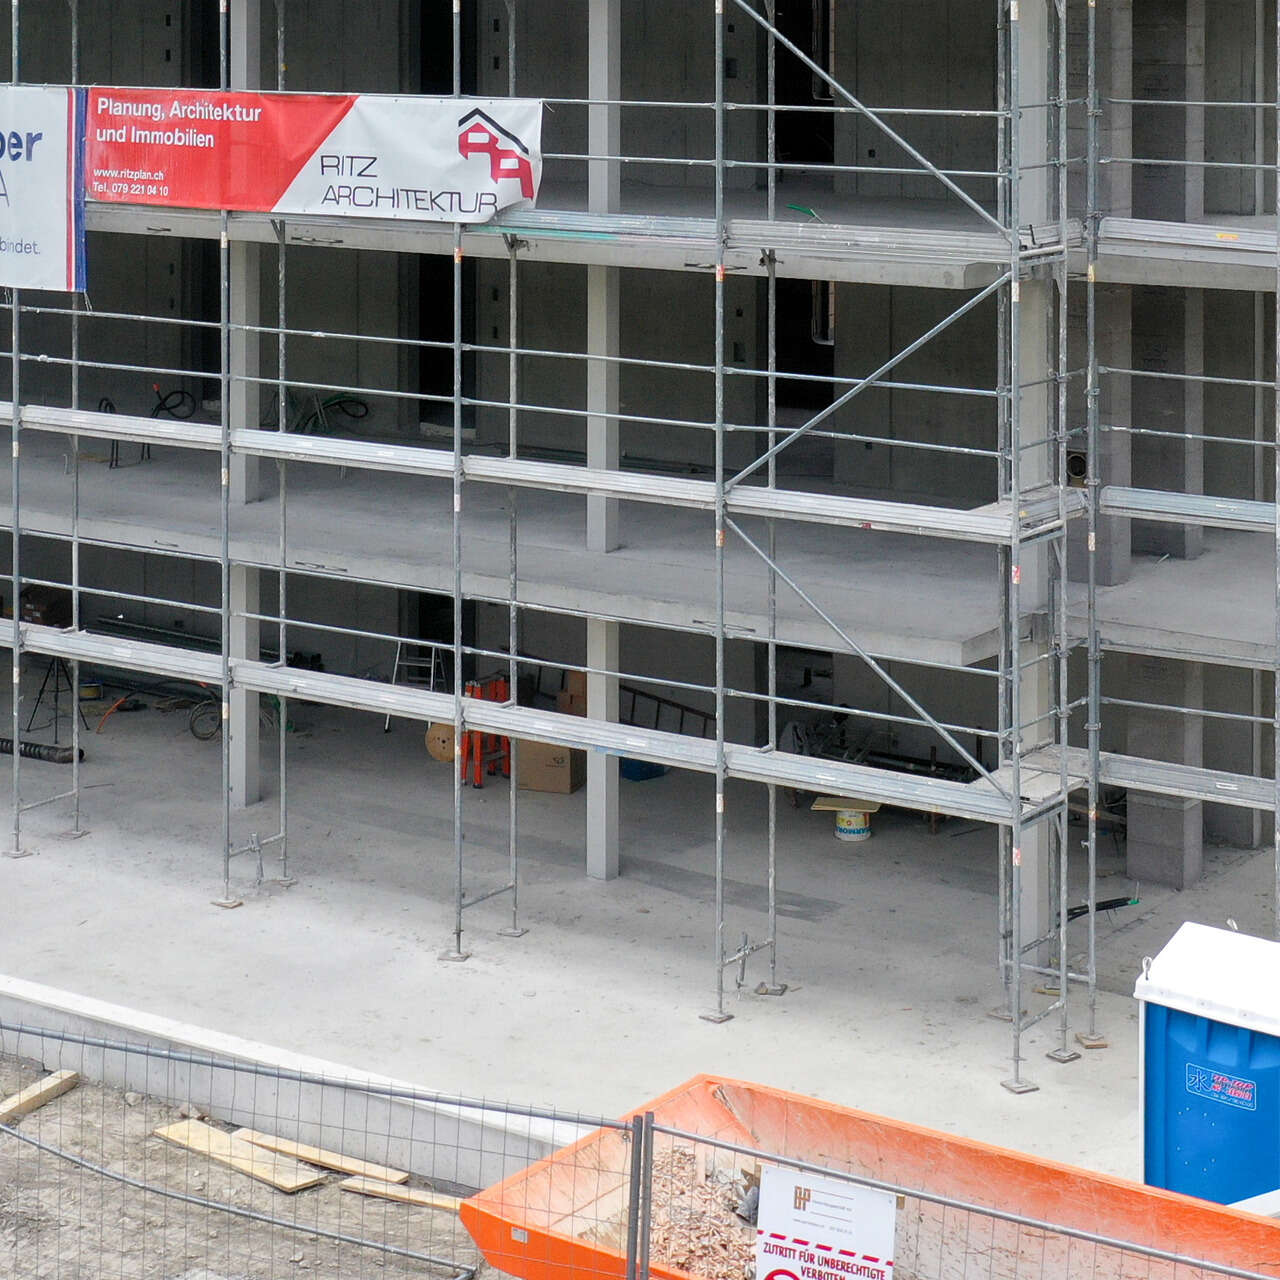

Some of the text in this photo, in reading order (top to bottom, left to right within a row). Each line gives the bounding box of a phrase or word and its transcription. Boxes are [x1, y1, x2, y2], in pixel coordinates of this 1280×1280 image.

[97, 98, 261, 122] Planung, Architektur
[96, 125, 214, 147] und Immobilien
[93, 168, 164, 181] www.ritzplan.ch
[320, 155, 378, 178] RITZ
[92, 182, 109, 193] Tel.
[111, 183, 128, 193] 079
[130, 184, 145, 195] 221
[159, 186, 169, 196] 10
[321, 185, 498, 214] ARCHITEKTUR
[763, 1242, 886, 1280] ZUTRITT FÜR UNBERECHTIGTE
